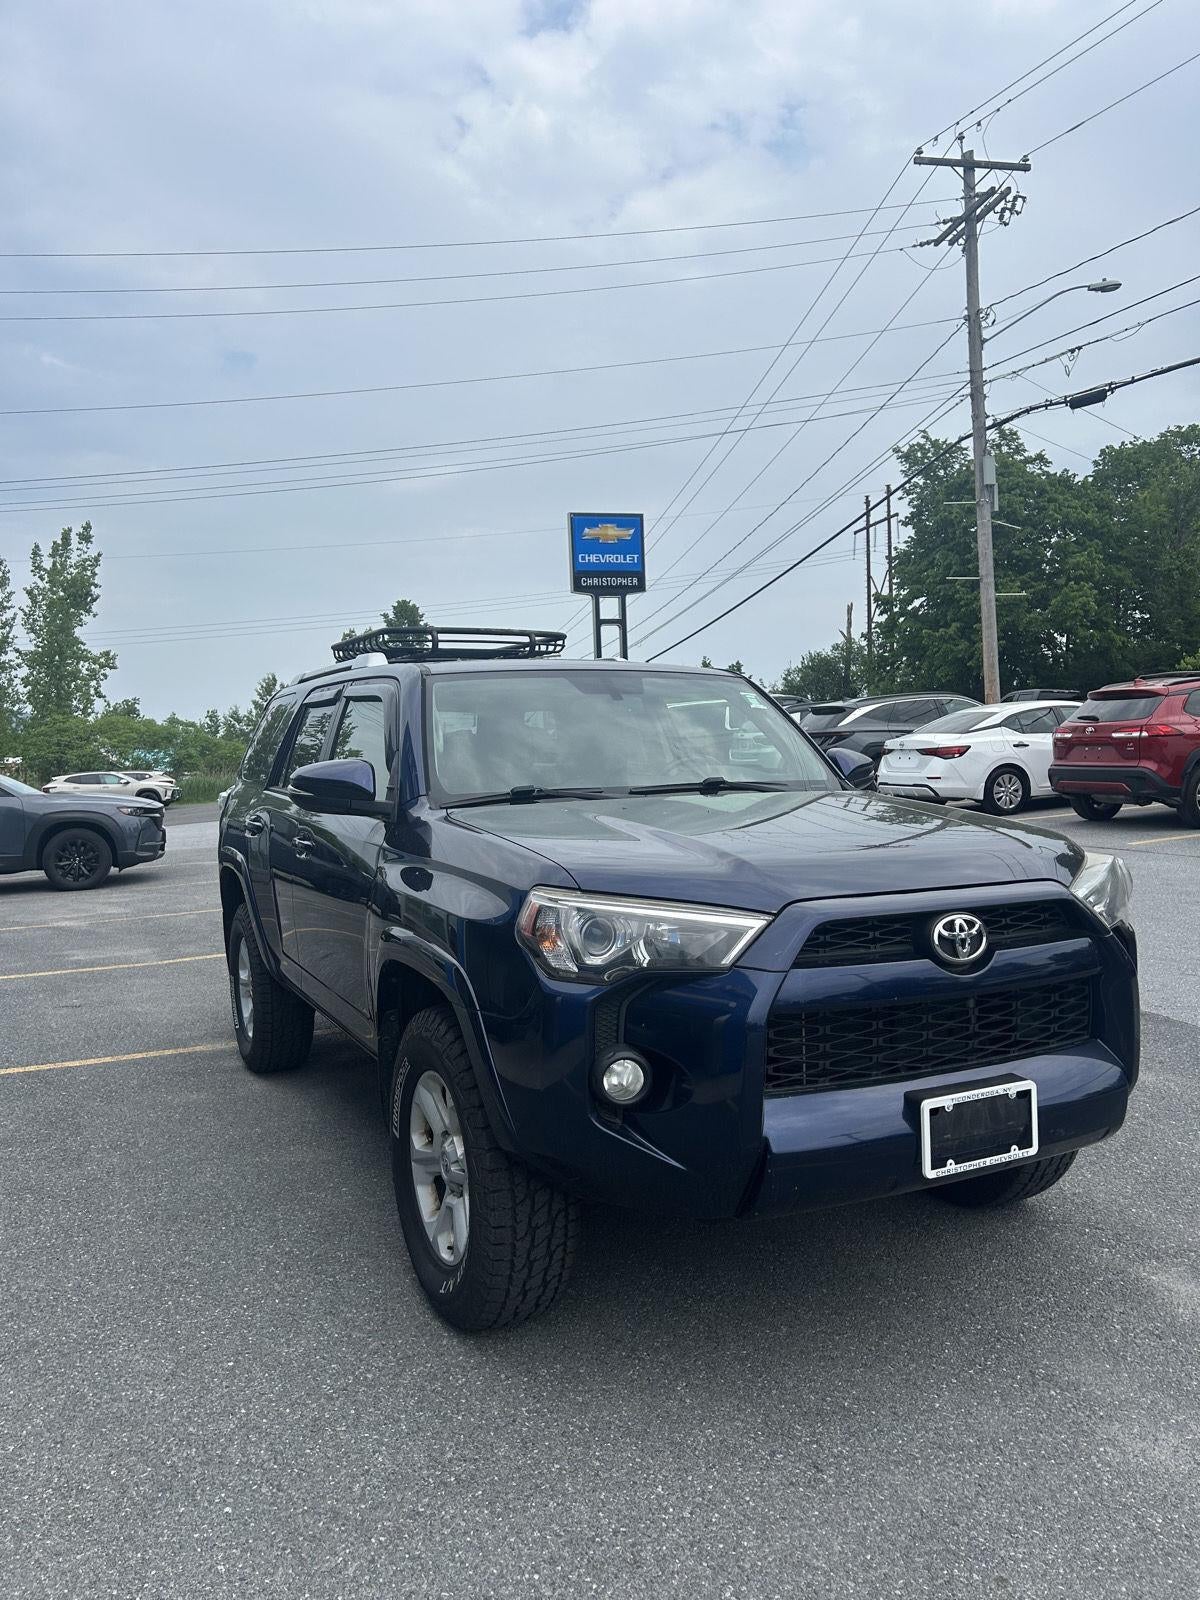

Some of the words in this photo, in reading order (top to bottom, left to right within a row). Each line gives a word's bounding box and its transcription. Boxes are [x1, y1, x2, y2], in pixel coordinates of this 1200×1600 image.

[578, 553, 639, 563] CHEVROLET
[581, 577, 638, 586] CHRISTOPHER
[935, 1161, 987, 1176] CHRISTOPHER
[989, 1150, 1030, 1165] CHEVROLET
